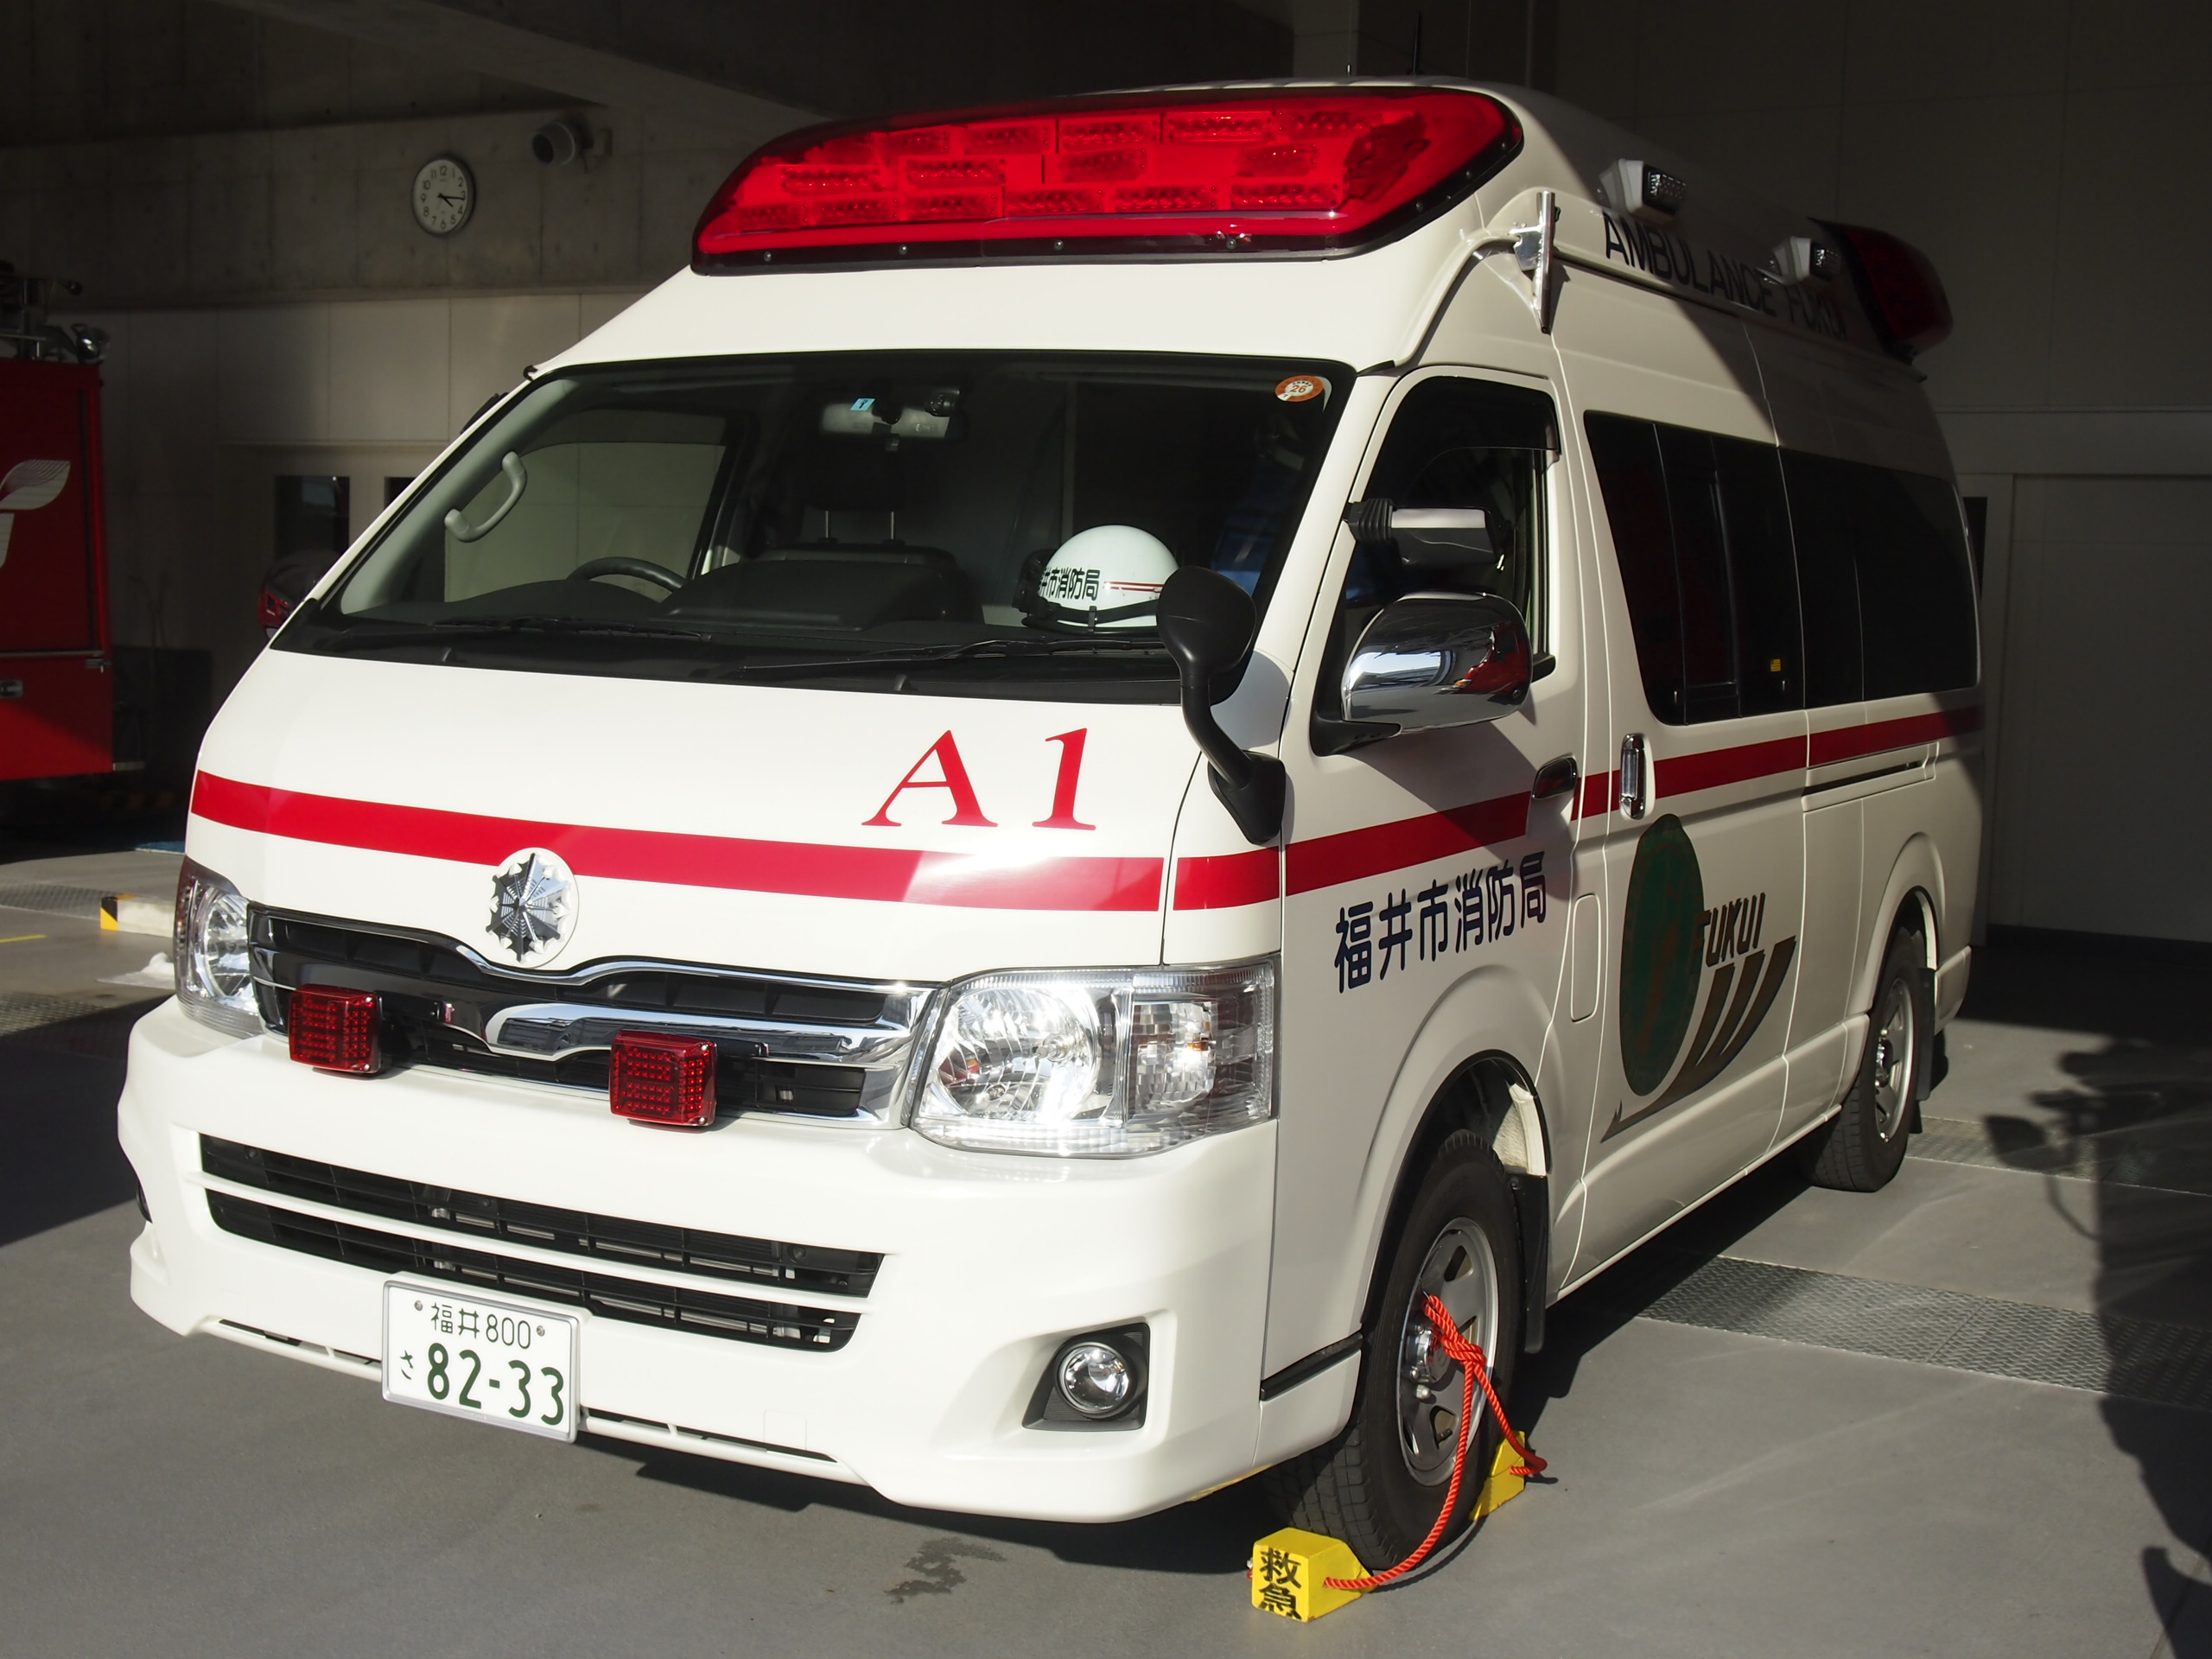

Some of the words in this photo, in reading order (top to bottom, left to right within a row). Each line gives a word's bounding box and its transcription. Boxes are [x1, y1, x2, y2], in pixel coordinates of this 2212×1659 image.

[430, 169, 437, 179] 11
[440, 165, 448, 176] 12
[423, 179, 431, 190] 10
[458, 176, 464, 188] 2
[420, 193, 427, 204] 9
[461, 190, 467, 200] 3
[423, 207, 429, 218] 8
[457, 205, 464, 214] 4
[432, 215, 437, 226] 7
[441, 219, 447, 230] 6
[450, 214, 456, 225] 5
[1603, 212, 1777, 318] AMBULANCE
[1290, 385, 1306, 393] 26
[861, 728, 1096, 831] A1
[1334, 851, 1547, 994] 福井市消防局
[1689, 893, 1765, 975] FUKUI
[400, 1350, 414, 1380] さ
[427, 1342, 564, 1426] 82-33
[1259, 1548, 1302, 1620] 救急
